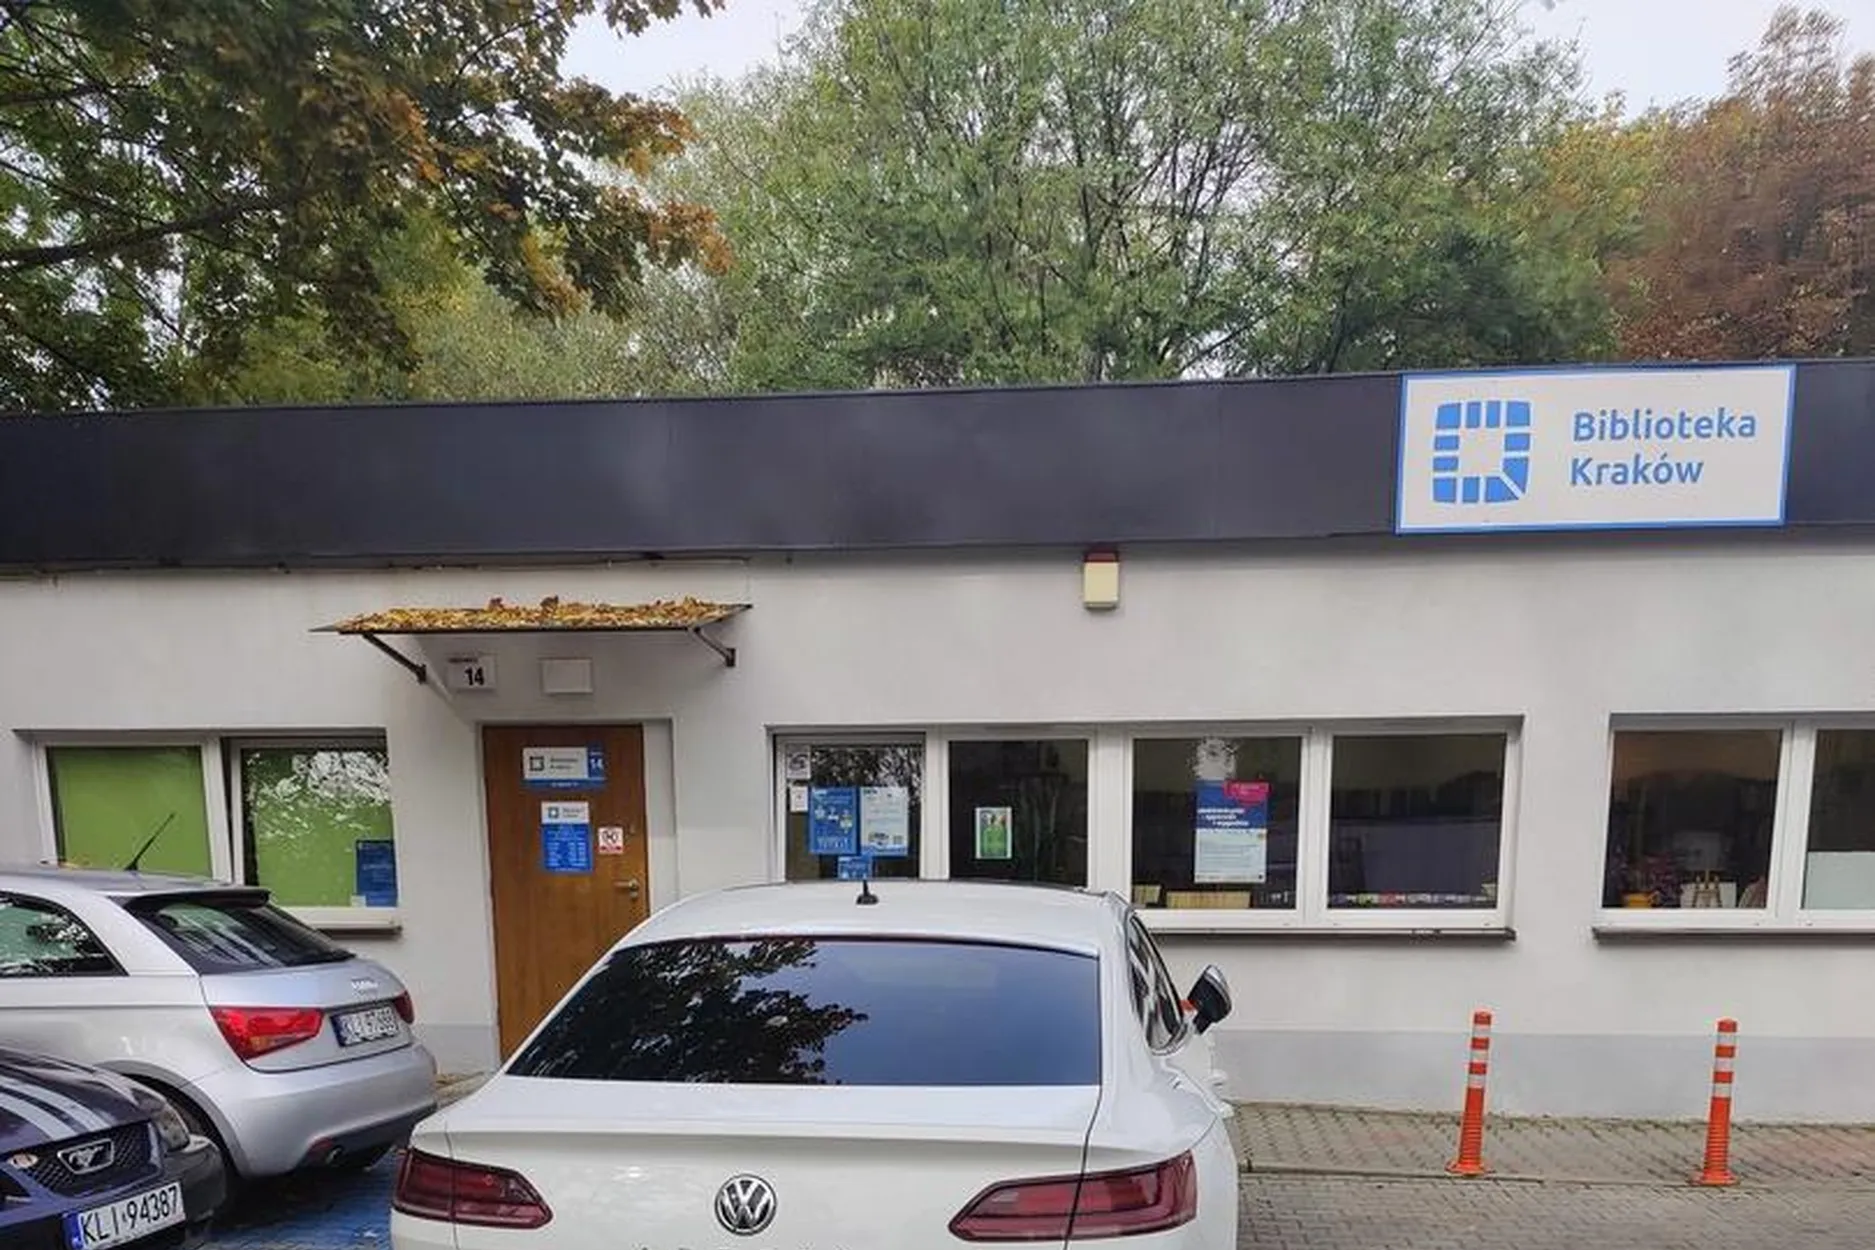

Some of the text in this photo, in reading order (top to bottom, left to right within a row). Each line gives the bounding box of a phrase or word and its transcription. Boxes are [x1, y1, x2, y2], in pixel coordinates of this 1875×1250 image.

[1573, 407, 1756, 441] Biblioteka
[1570, 452, 1704, 486] Kraków
[464, 667, 485, 686] 14
[80, 1185, 178, 1245] KLI 94387
